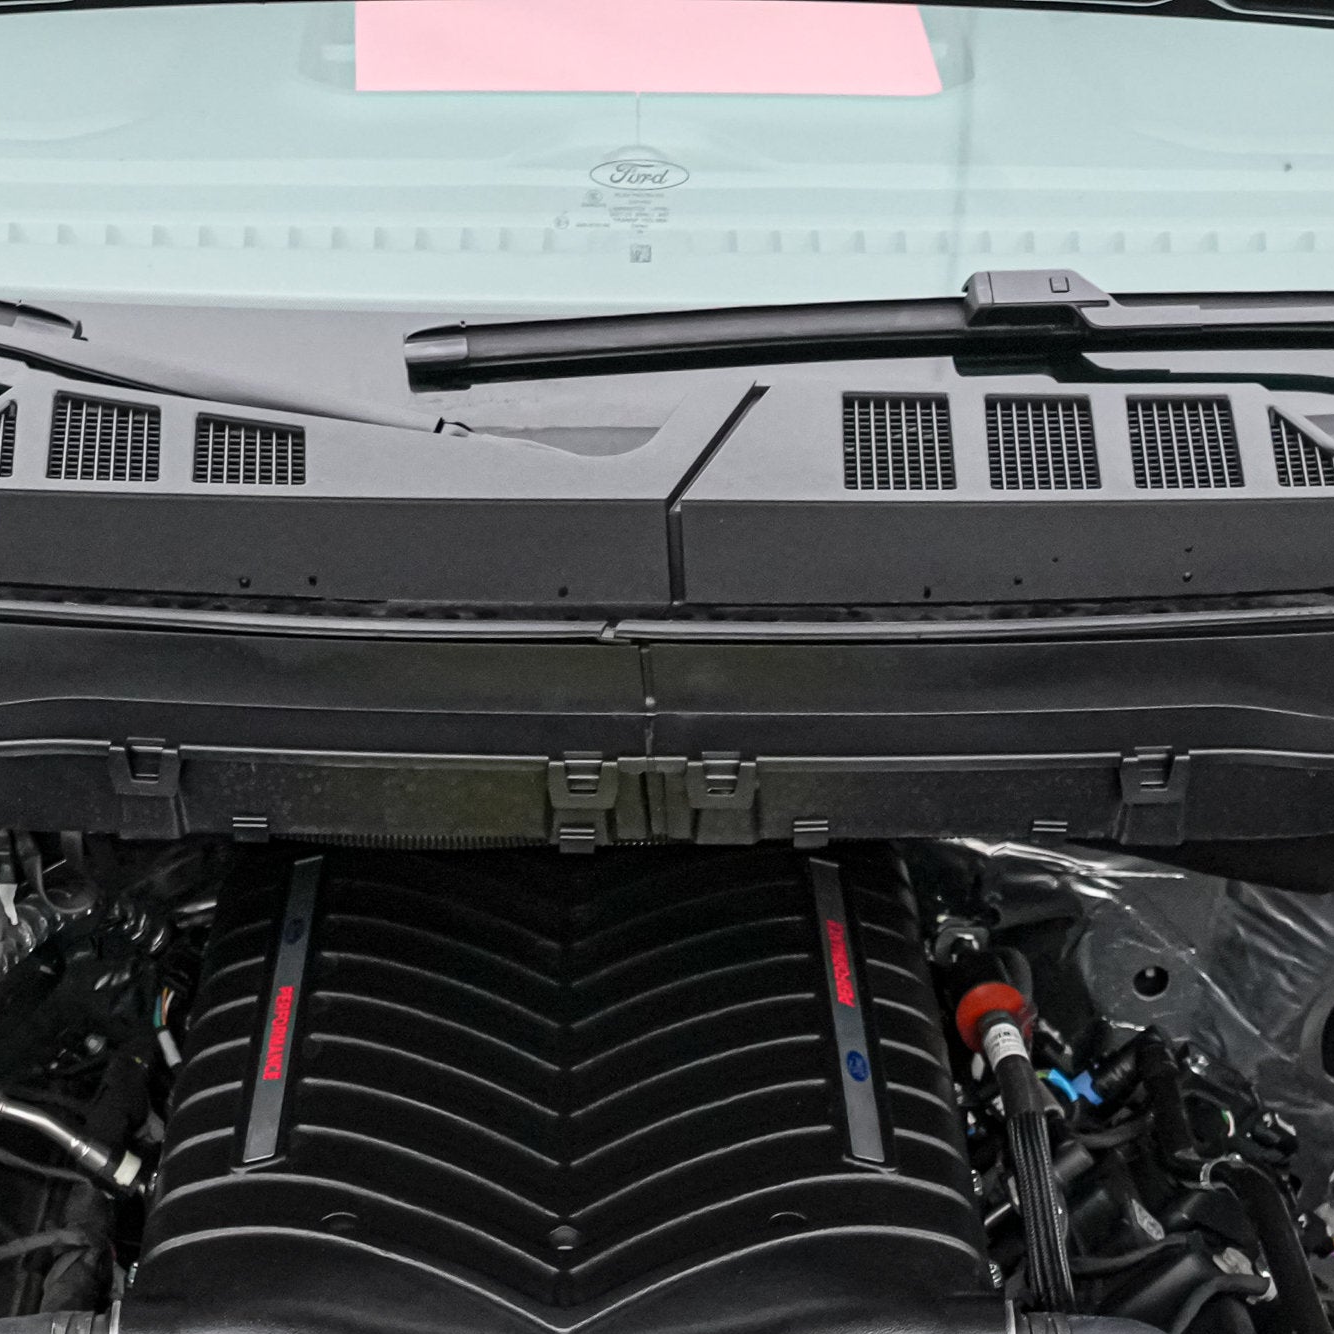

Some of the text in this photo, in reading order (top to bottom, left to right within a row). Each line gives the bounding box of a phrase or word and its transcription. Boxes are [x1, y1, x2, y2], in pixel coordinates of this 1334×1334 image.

[610, 162, 669, 184] Ford
[826, 919, 856, 1008] PERFORMANCE
[262, 985, 295, 1080] PERFORMANCE
